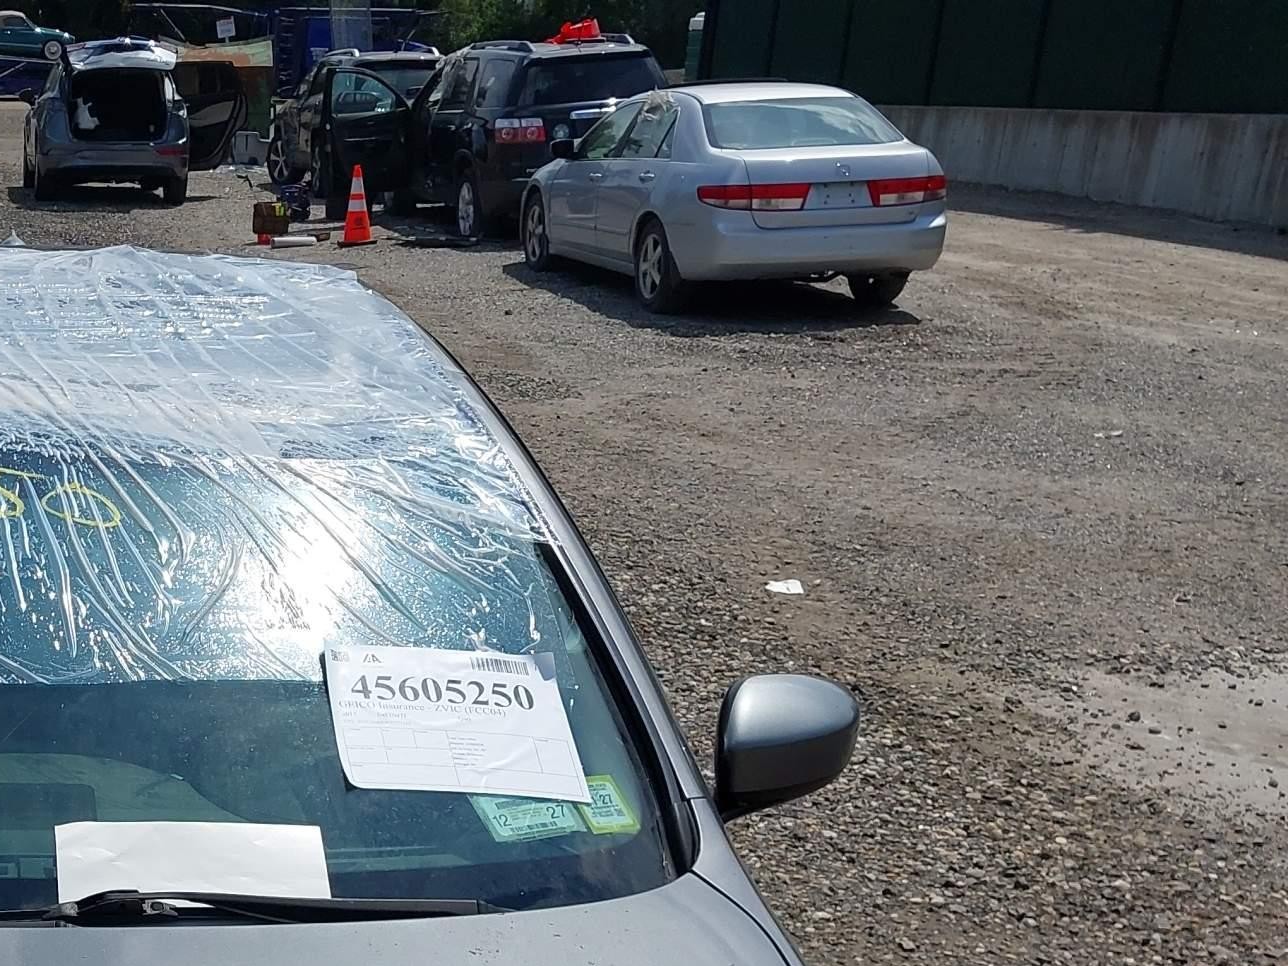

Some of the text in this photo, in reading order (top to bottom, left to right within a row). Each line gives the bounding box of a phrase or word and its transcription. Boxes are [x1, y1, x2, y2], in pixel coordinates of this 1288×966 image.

[351, 674, 535, 711] 45605250
[546, 804, 566, 819] 27
[492, 814, 512, 828] 12
